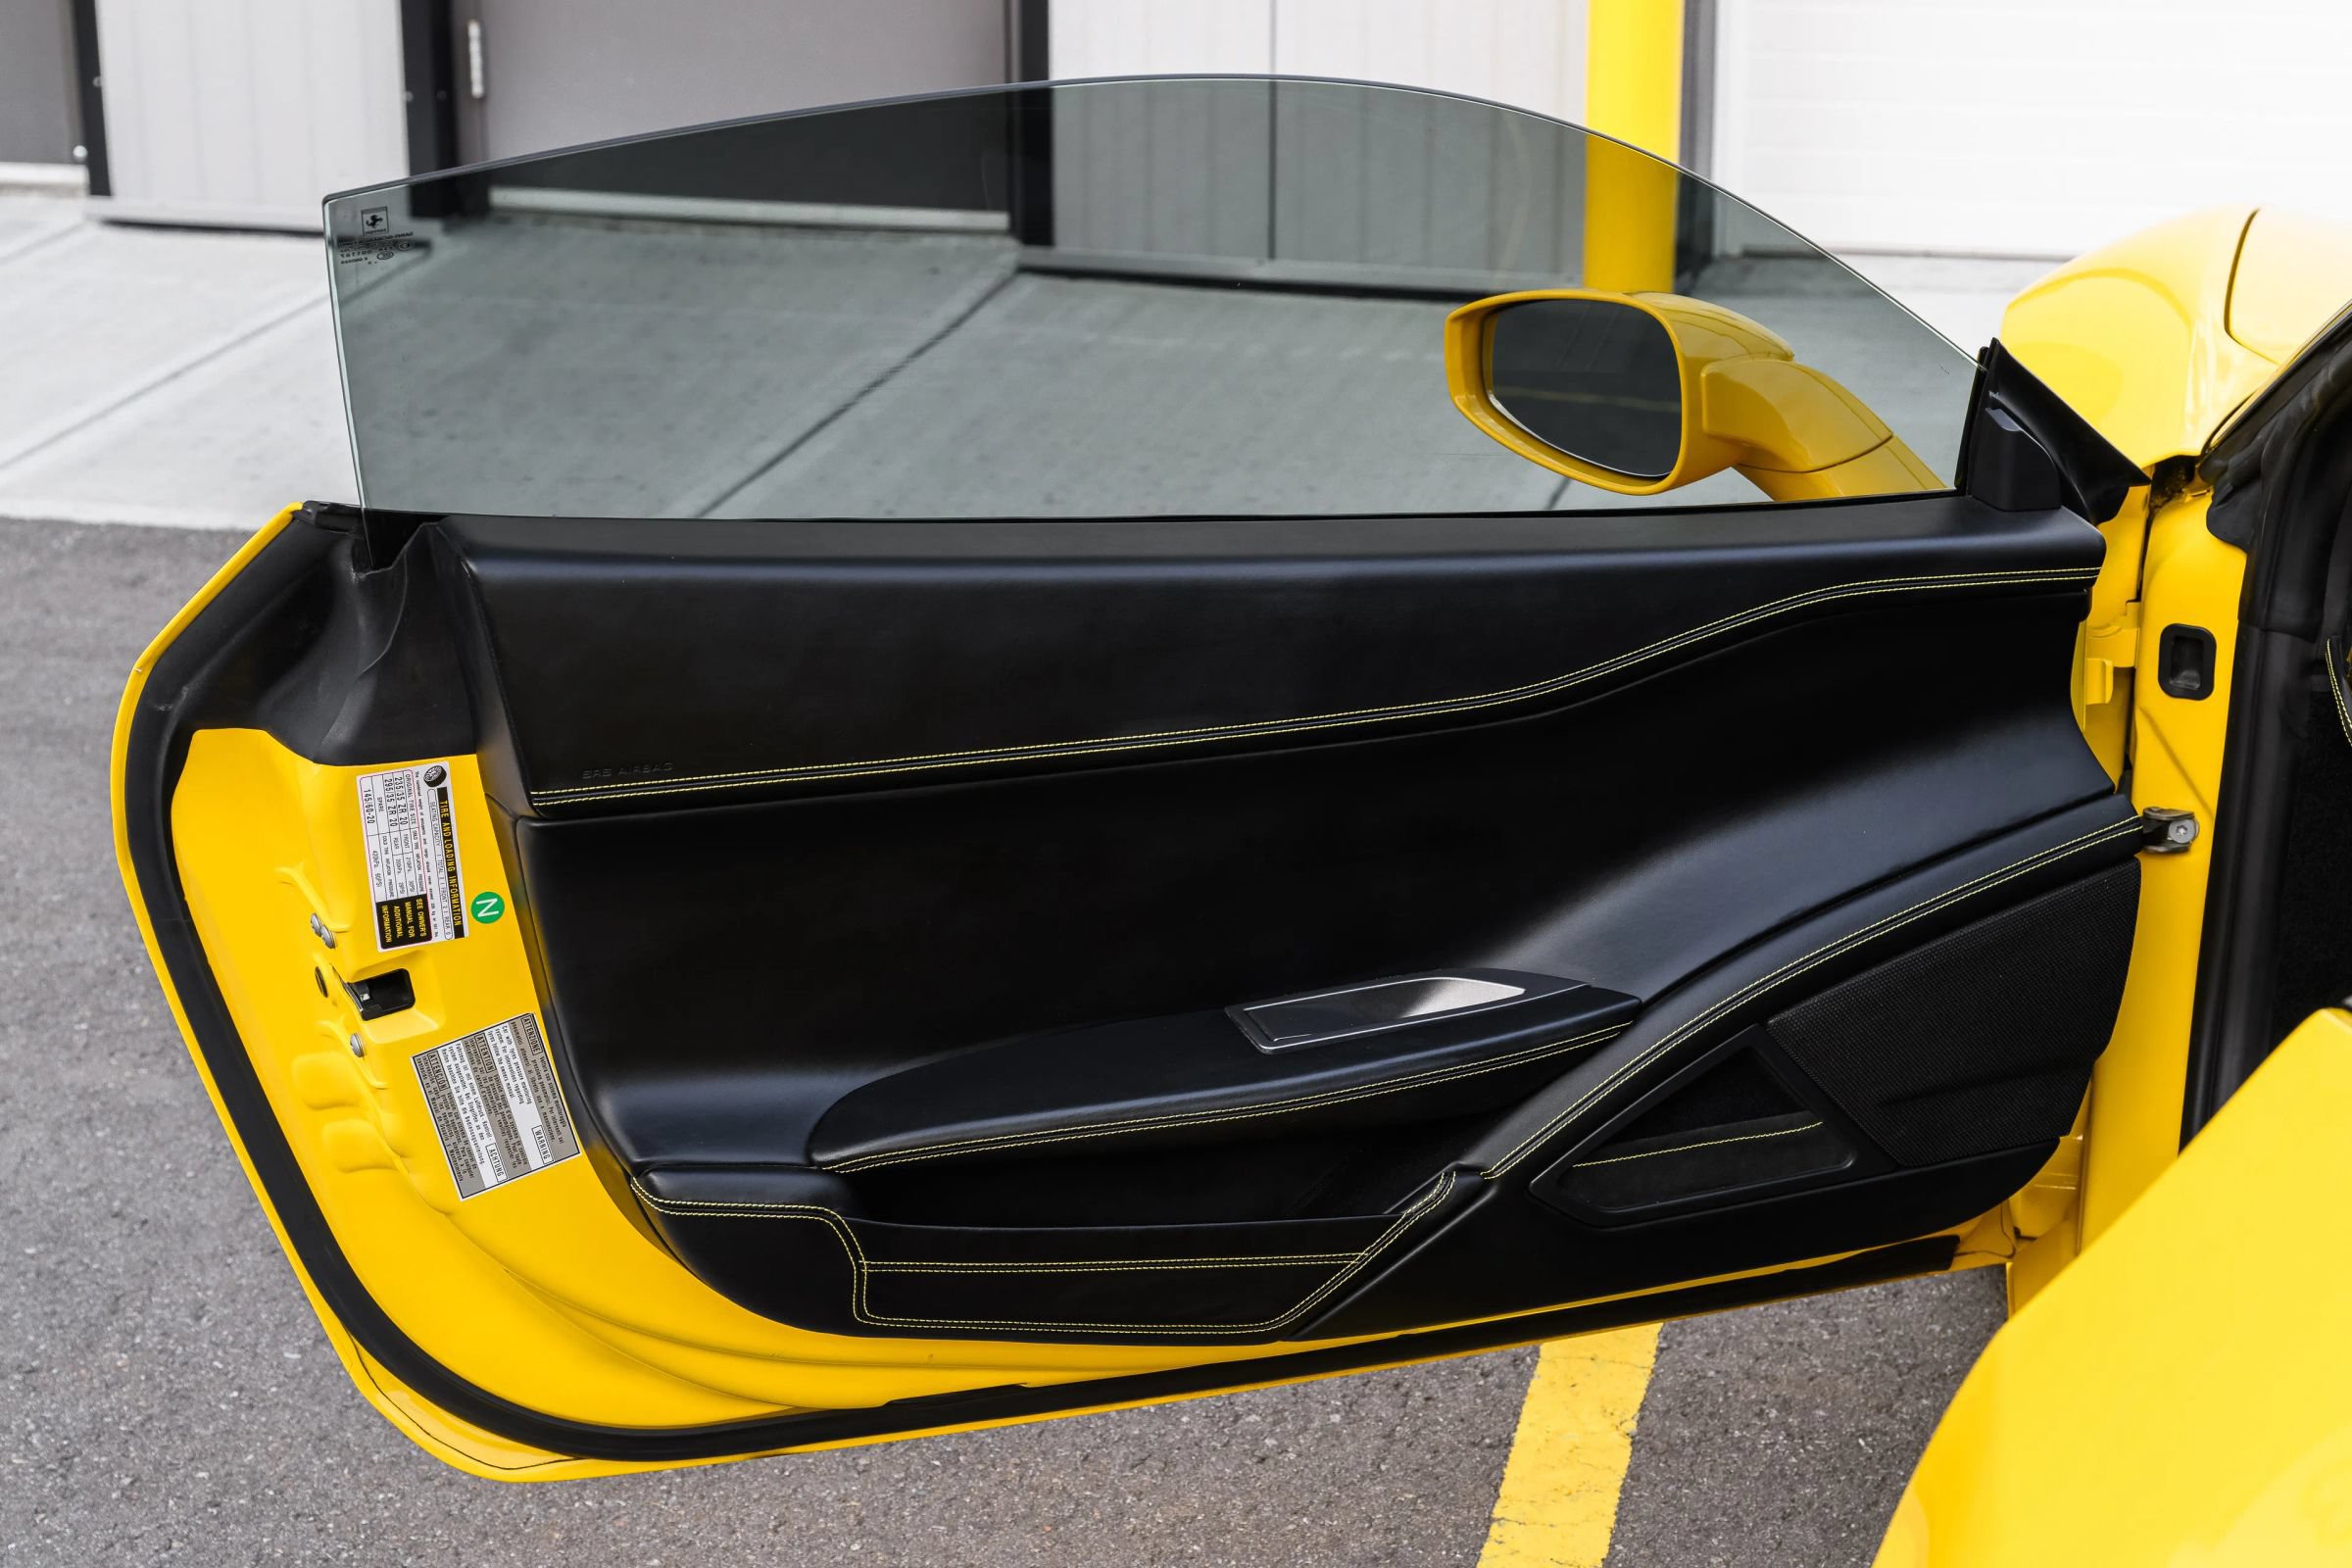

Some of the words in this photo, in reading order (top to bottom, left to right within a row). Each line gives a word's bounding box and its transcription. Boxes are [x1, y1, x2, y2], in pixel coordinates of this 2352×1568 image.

[581, 768, 612, 780] SRS
[617, 762, 674, 777] AIRBAG
[384, 779, 394, 803] 295/35
[395, 777, 405, 801] 235/35
[364, 789, 375, 824] 145/60-20
[398, 804, 407, 813] ZR
[439, 801, 449, 818] TIRE
[442, 822, 451, 837] AND
[444, 839, 456, 872] LOADING
[405, 902, 414, 924] MANUAL
[449, 875, 463, 926] INFORMATION
[476, 898, 499, 917] N
[381, 905, 392, 943] INFORMATION
[393, 906, 404, 938] ADDITIONAL
[417, 911, 426, 937] OWNER'S
[523, 1017, 540, 1053] ATTENZIONE
[477, 1036, 494, 1071] ATTENTION
[535, 1130, 550, 1159] WARNING
[489, 1149, 504, 1177] ACHTUNG
